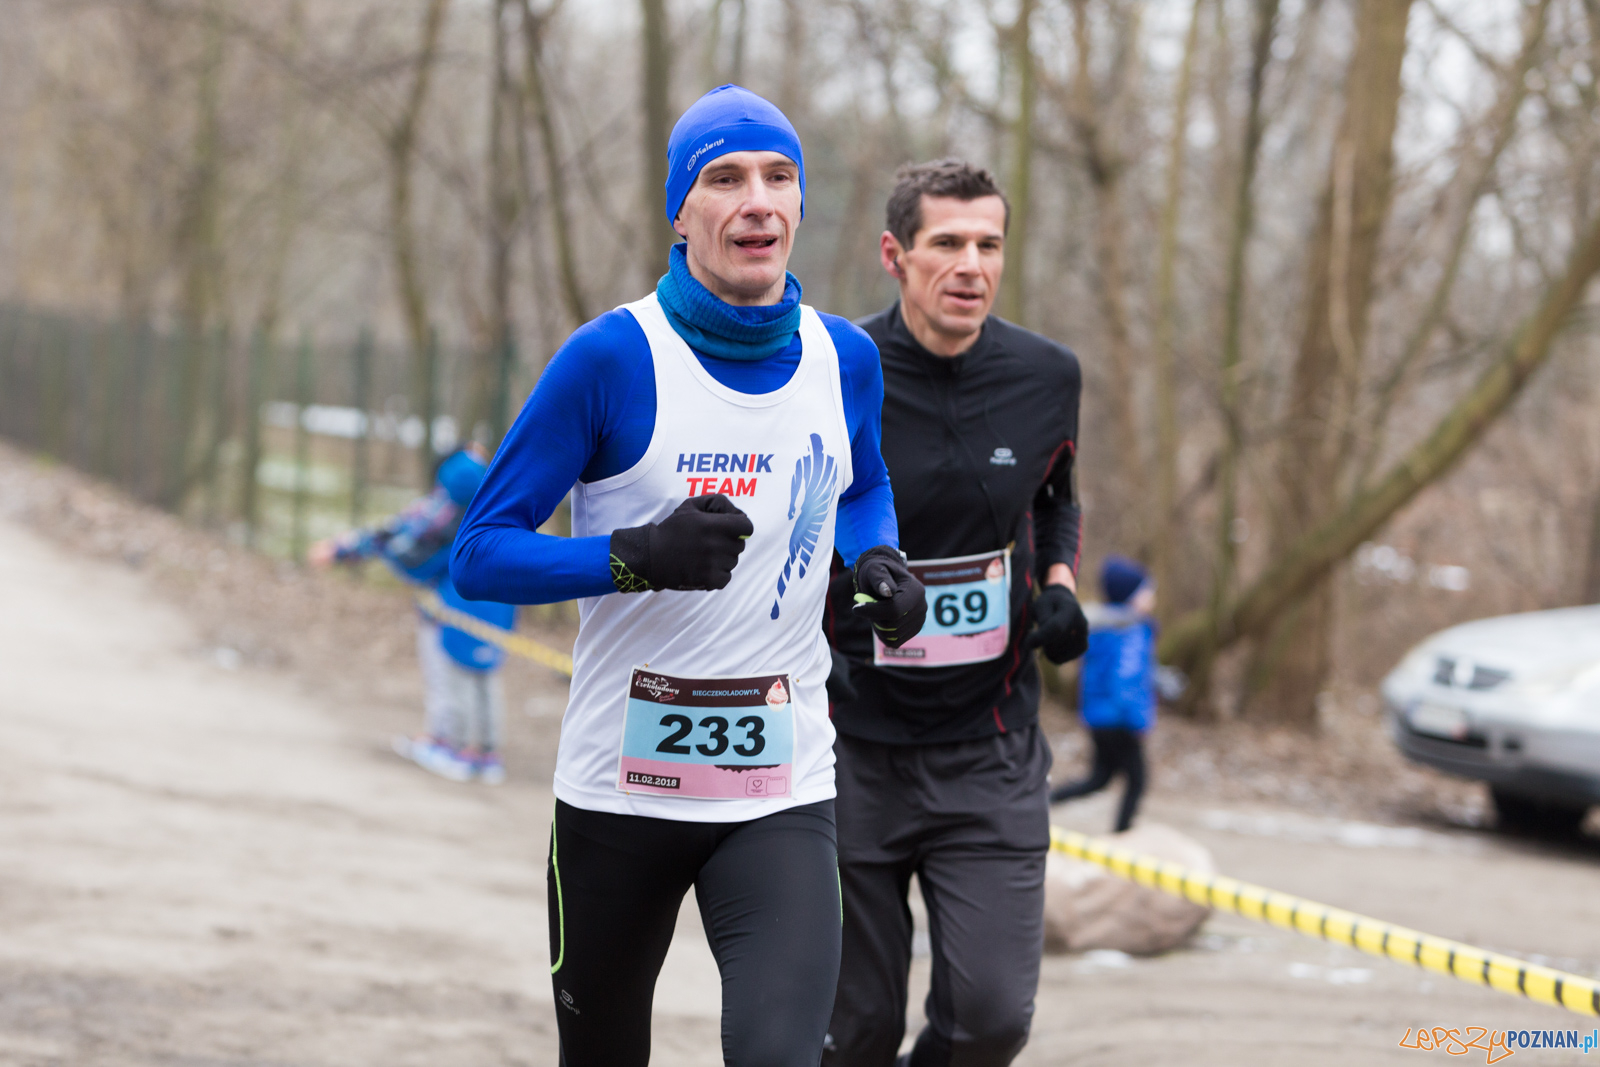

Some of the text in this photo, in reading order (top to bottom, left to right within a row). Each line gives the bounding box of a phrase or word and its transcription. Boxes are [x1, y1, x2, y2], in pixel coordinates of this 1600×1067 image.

[676, 453, 775, 473] HERNIK
[686, 477, 757, 497] TEAM
[932, 589, 988, 627] 69
[692, 688, 760, 697] BIEGCZEKOLADOWY.PL
[655, 713, 766, 757] 233
[628, 773, 678, 788] 11.02.2018
